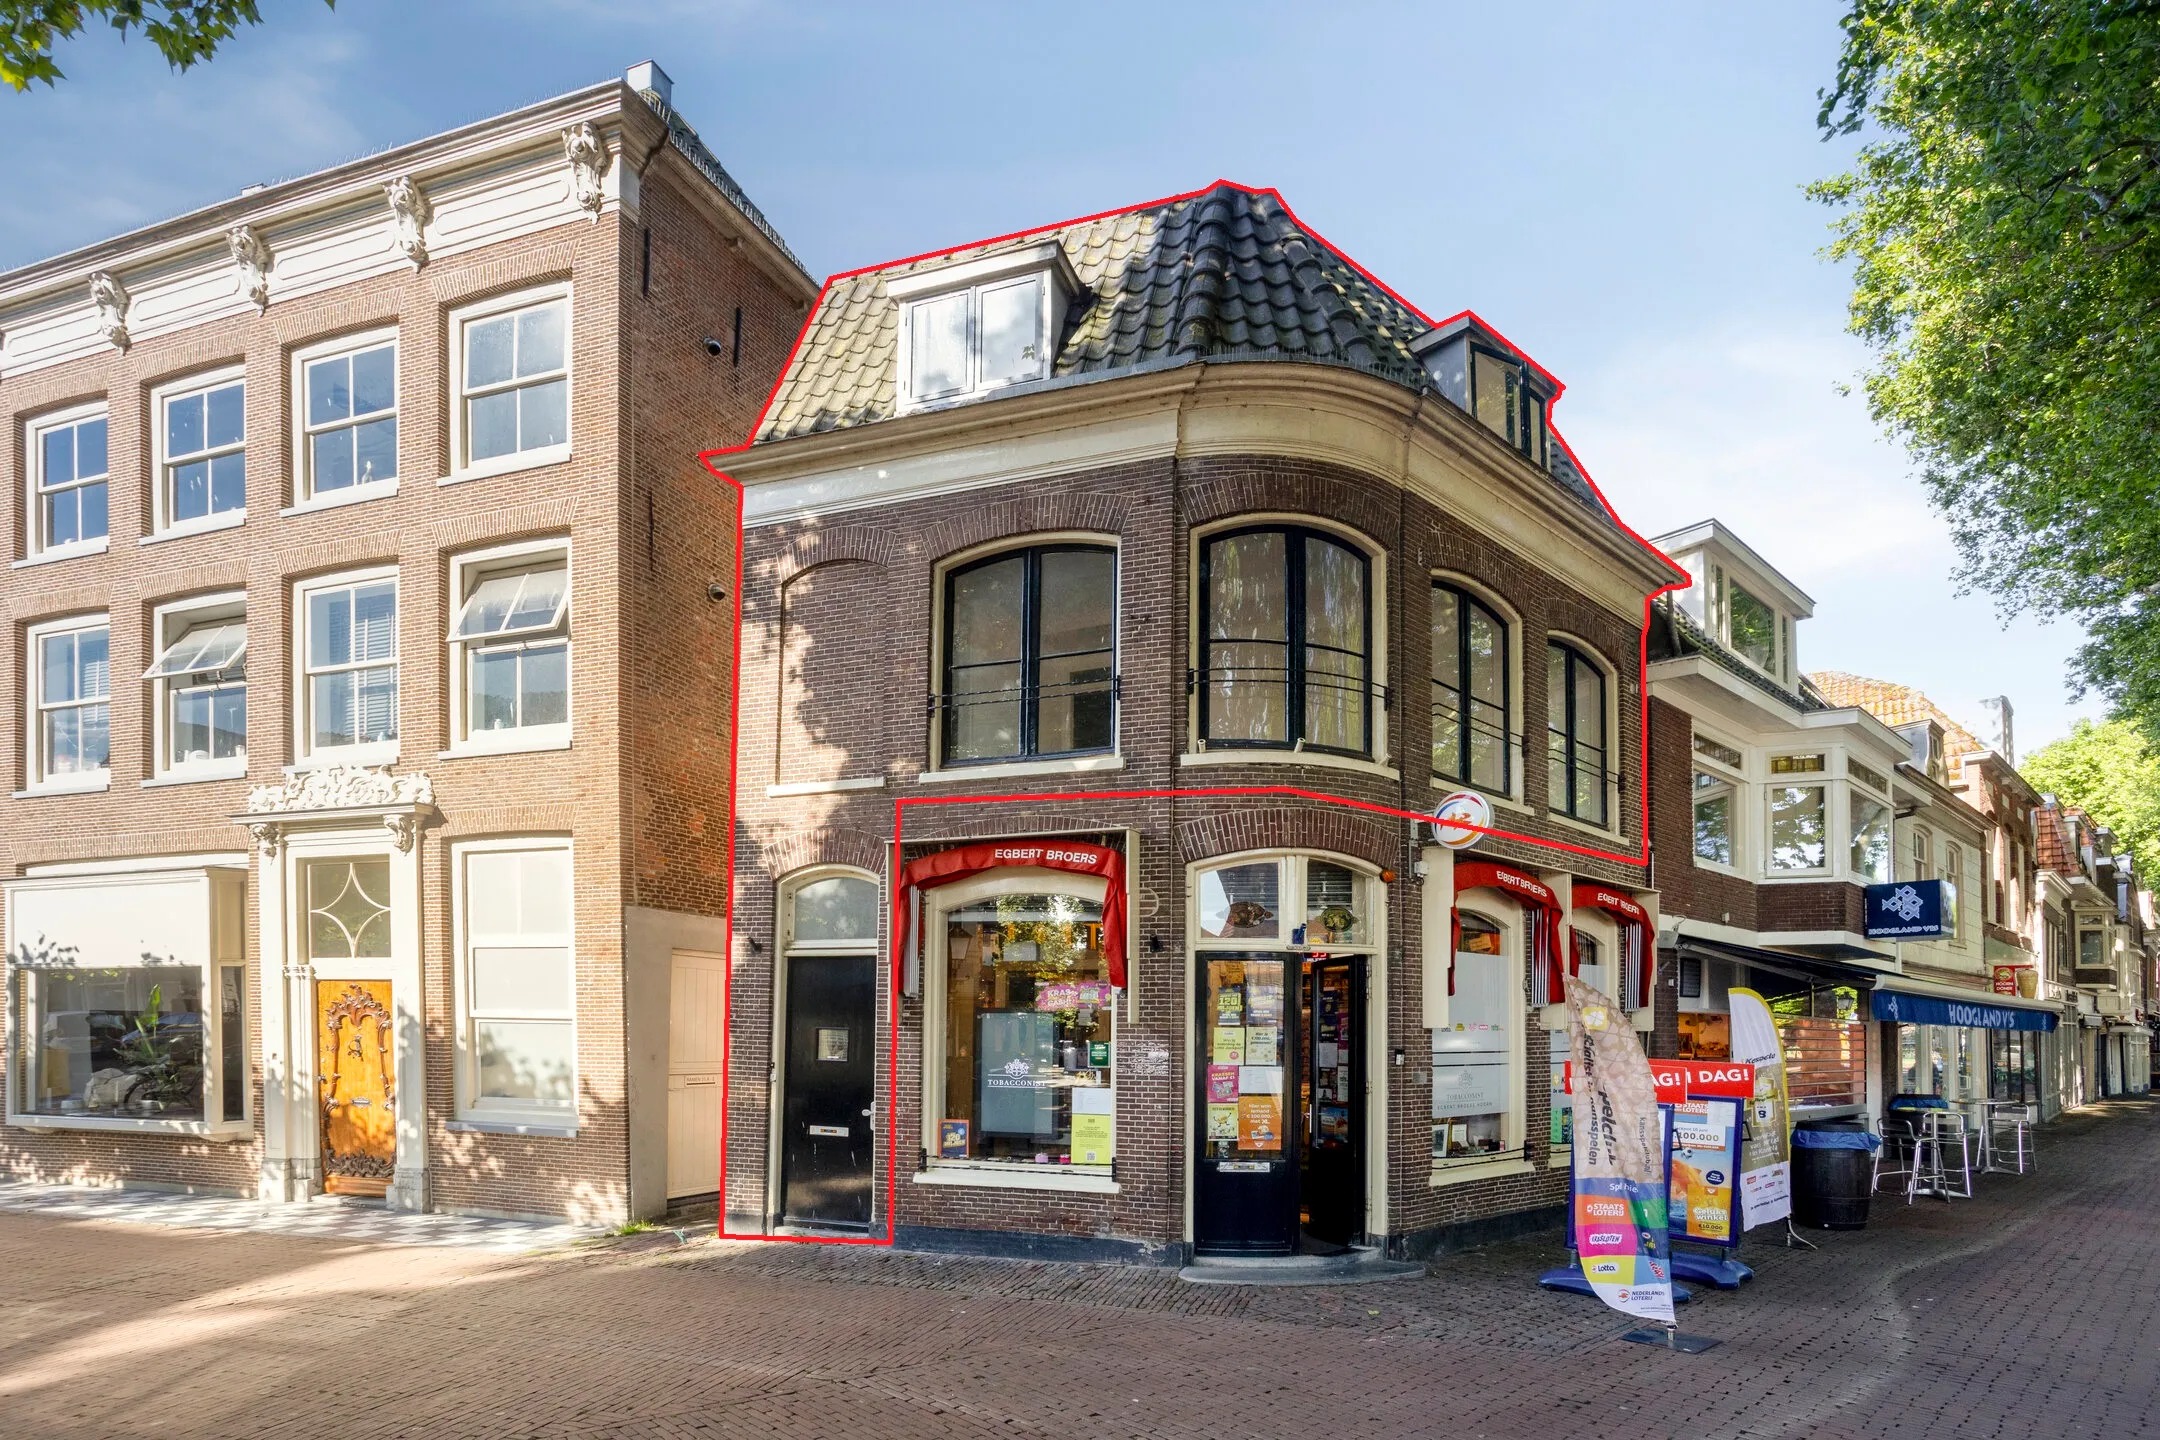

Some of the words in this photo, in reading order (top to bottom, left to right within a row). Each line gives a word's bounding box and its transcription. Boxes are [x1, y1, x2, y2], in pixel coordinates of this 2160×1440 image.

[994, 848, 1044, 859] EGBERT
[1046, 850, 1098, 864] BROERS
[1698, 1068, 1750, 1083] DAG!
[1593, 1203, 1625, 1211] STAATS
